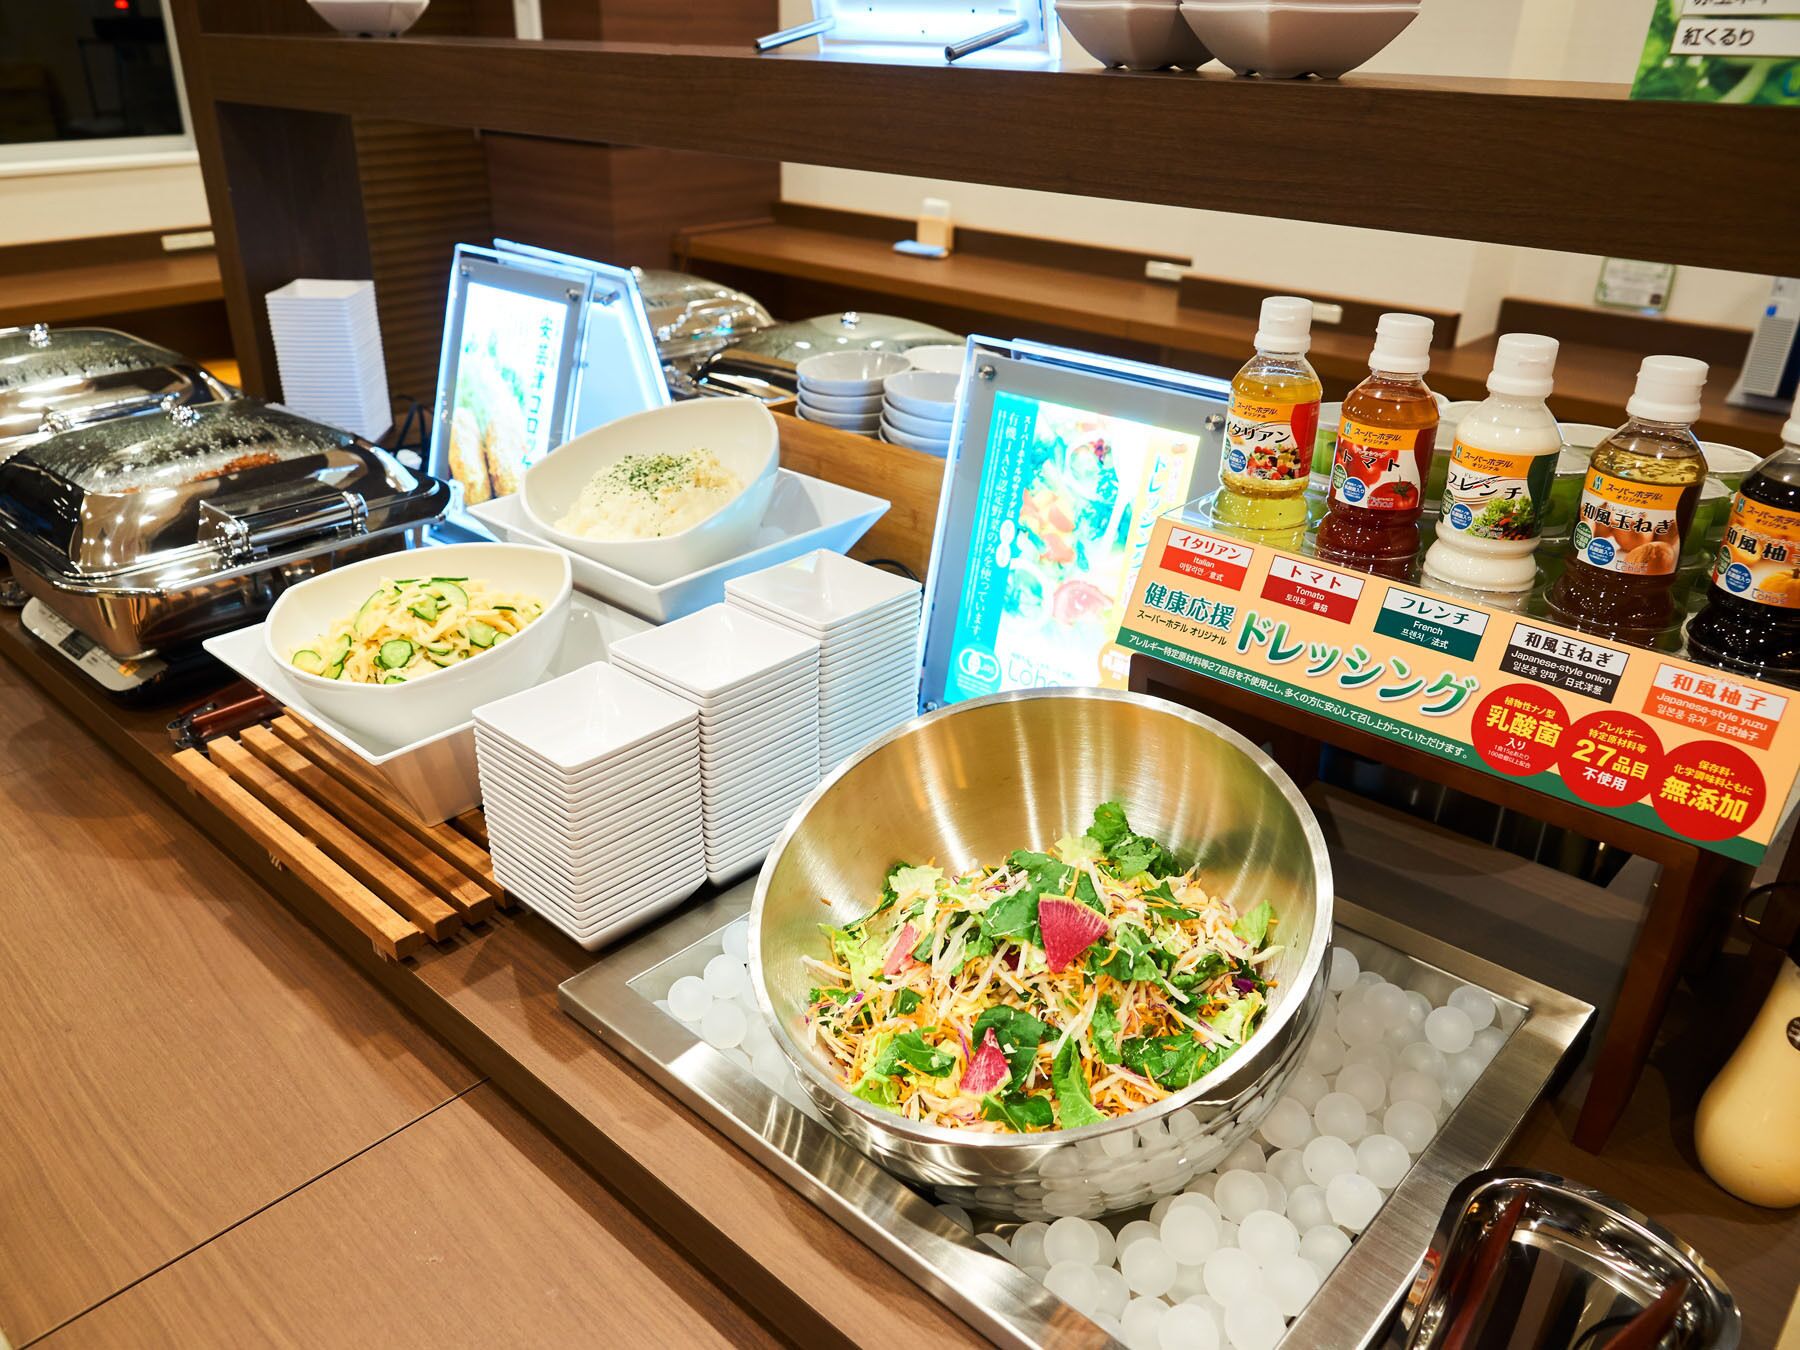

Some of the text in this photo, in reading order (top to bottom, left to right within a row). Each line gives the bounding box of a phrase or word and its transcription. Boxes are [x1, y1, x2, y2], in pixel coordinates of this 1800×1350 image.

[1682, 27, 1755, 46] 紅くるり
[1237, 402, 1277, 415] スーパーホテル
[1244, 411, 1266, 419] オリジナル
[1227, 421, 1290, 443] イタリアン
[1354, 427, 1401, 441] スーパーホテル
[1363, 438, 1389, 446] オリジナル
[1344, 449, 1400, 472] トマト
[1464, 452, 1513, 468] スーパーホテル
[1472, 463, 1500, 471] オリジナル
[1448, 471, 1522, 500] フレンチ
[1605, 483, 1663, 500] スーパーホテル
[1616, 495, 1648, 504] オリジナル
[1583, 502, 1674, 534] 和風玉ねぎ
[1756, 518, 1788, 530] オリジナル
[1179, 535, 1241, 559] イタリアン
[1193, 556, 1215, 568] Italian
[1290, 565, 1341, 589] トマト
[1296, 585, 1325, 600] Tomato
[1144, 582, 1235, 630] 健康応援
[1400, 597, 1469, 625] フレンチ
[1137, 609, 1227, 646] スーパーホテル オリジナル
[1413, 620, 1443, 636] French
[1524, 631, 1614, 667] 和風玉ねぎ
[1237, 612, 1475, 713] ドレッシング
[1511, 650, 1612, 685] Japanese-style onion
[1513, 661, 1538, 675] 일본풍
[1129, 634, 1468, 760] アレルギー特定原材料等27品目を不使用とし、多くの方に安心して召し上がっていただけます。
[1671, 673, 1767, 711] 和風柚子
[1504, 695, 1556, 719] 植物性ナノ型
[1656, 692, 1768, 732] Japanese-style yuzu
[1657, 703, 1685, 720] 일본풍
[1486, 704, 1564, 748] 乳酸菌
[1598, 720, 1644, 739] アレルギー
[1505, 737, 1526, 751] 入り
[1588, 728, 1648, 754] 特定原材料等
[1571, 738, 1650, 780] 27品目
[1582, 766, 1628, 792] 不使用
[1673, 763, 1754, 796] 化学調味料ともに
[1658, 775, 1750, 824] 無添加
